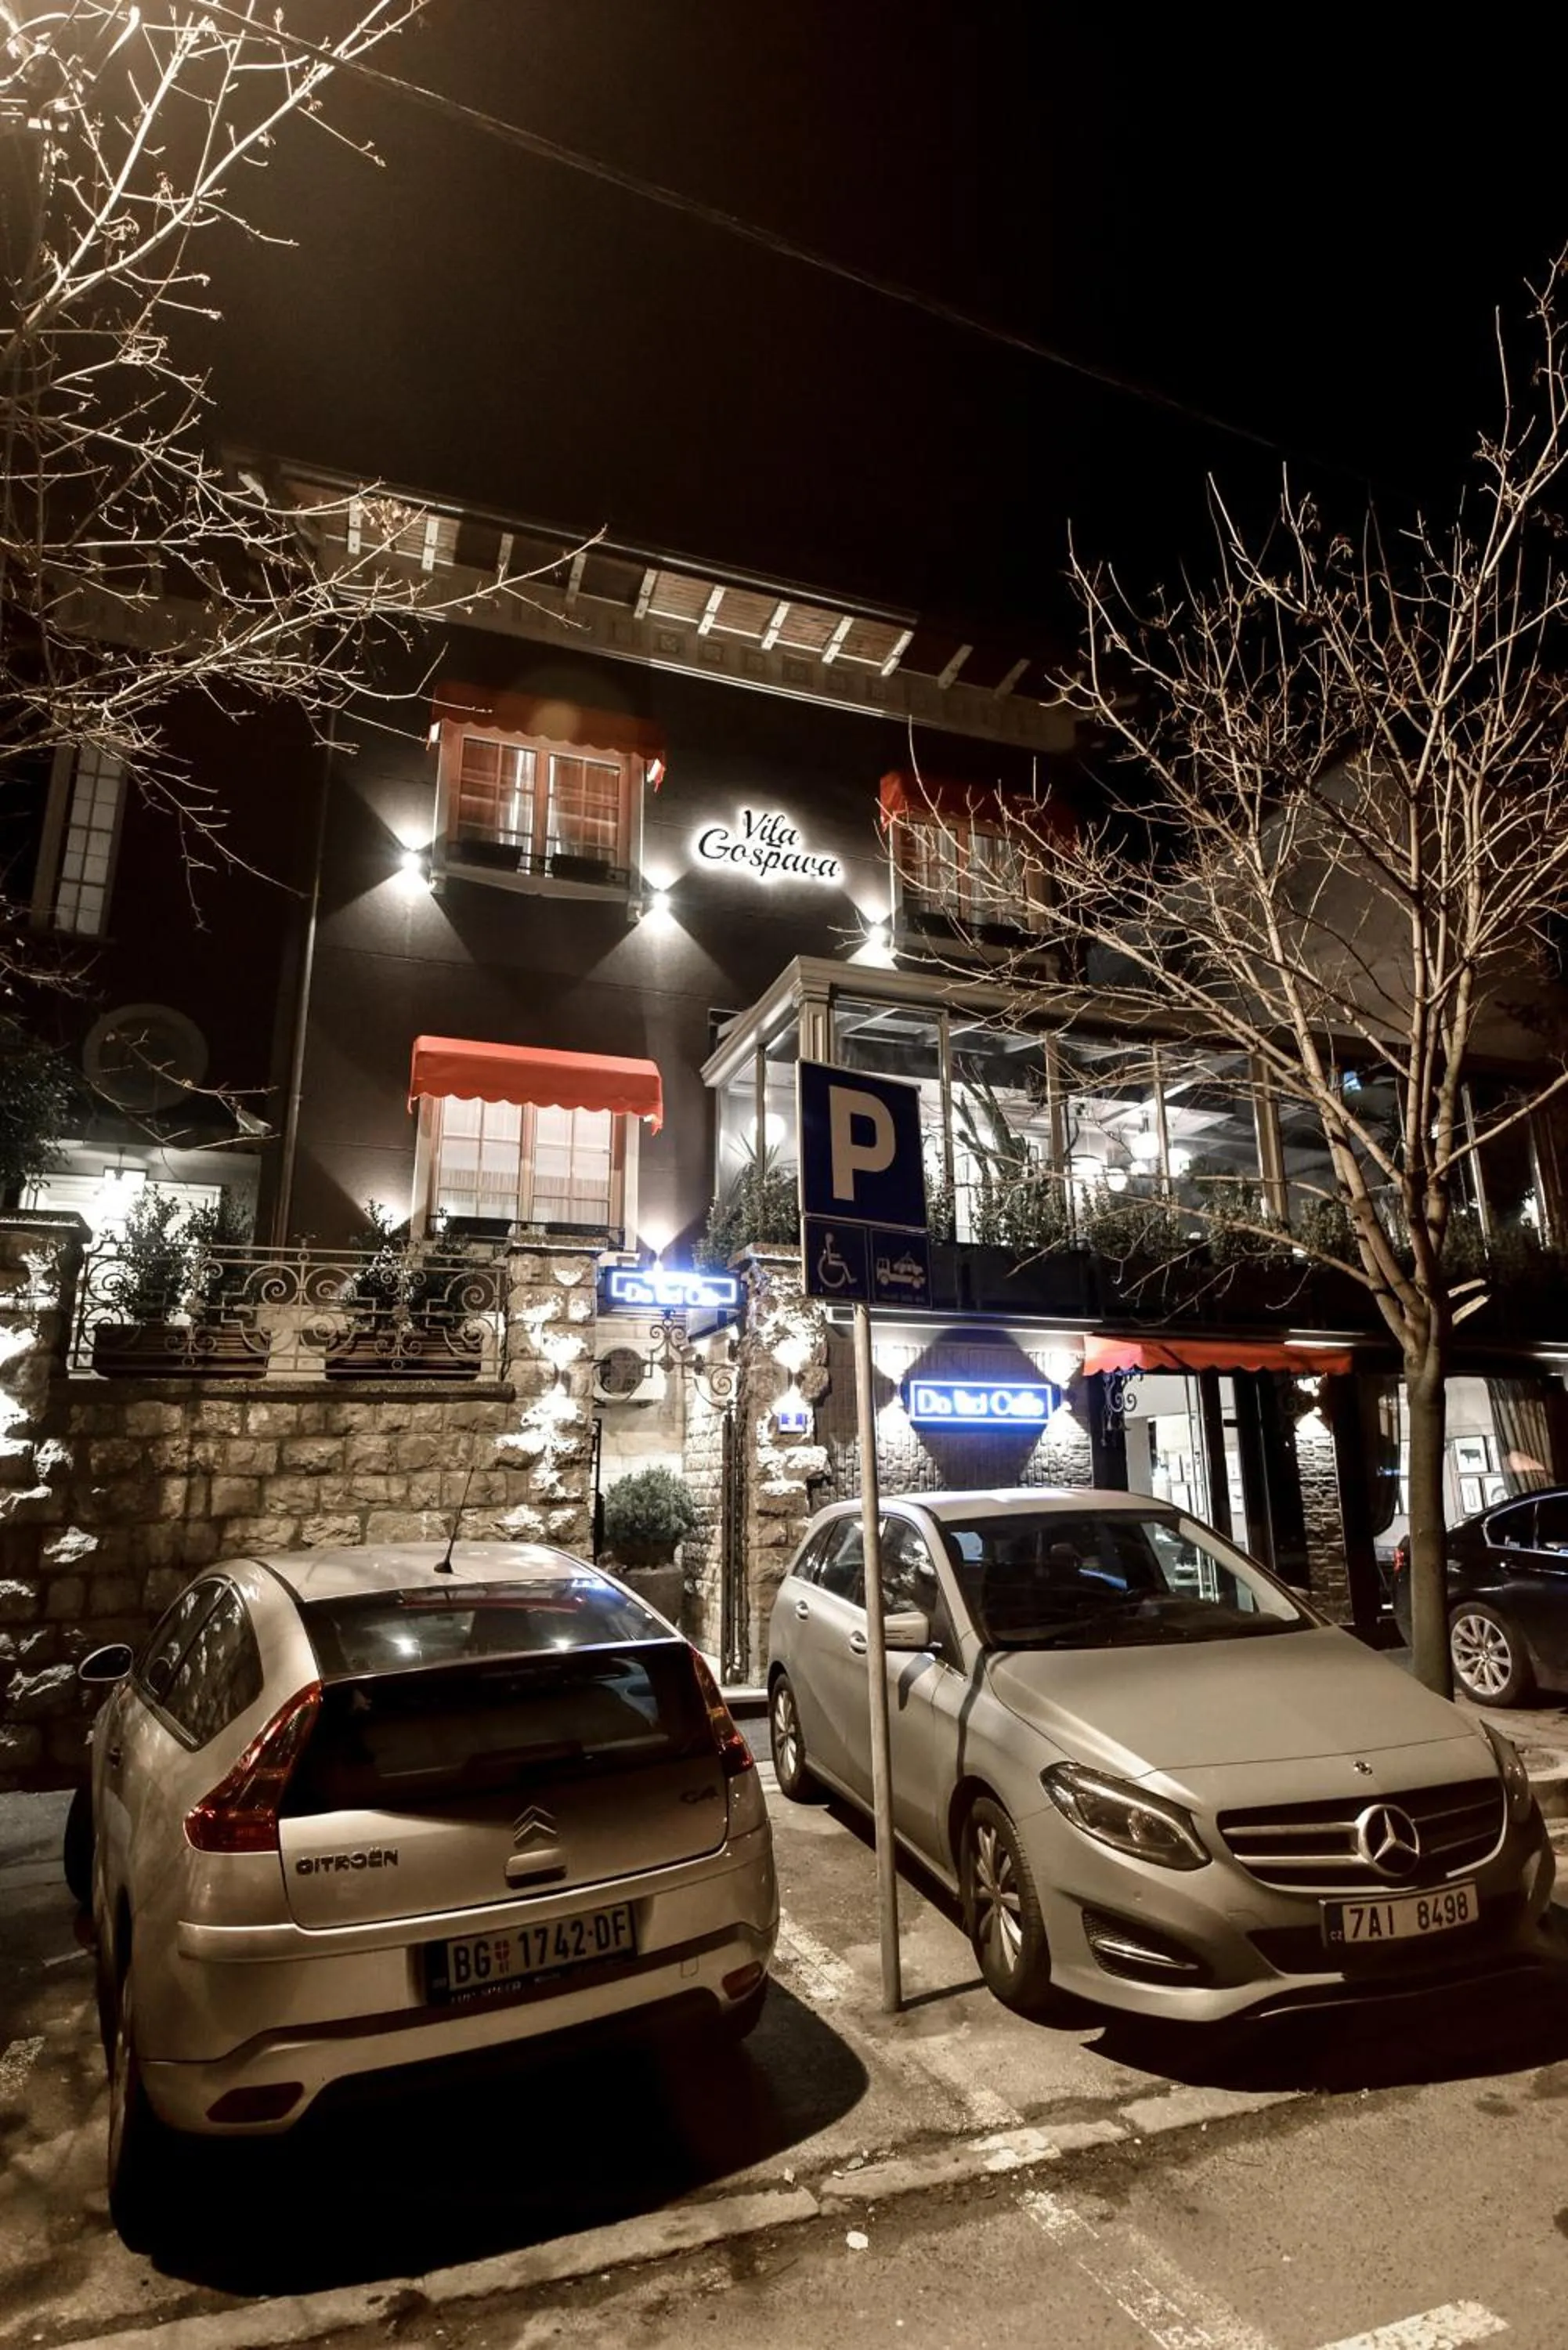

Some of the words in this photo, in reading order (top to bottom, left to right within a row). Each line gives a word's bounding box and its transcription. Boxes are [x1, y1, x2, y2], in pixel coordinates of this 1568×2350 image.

[744, 809, 799, 845] Vila
[698, 828, 840, 876] Gospava
[829, 1085, 897, 1202] P
[295, 1847, 399, 1875] CITROËN
[1349, 1904, 1395, 1939] 7AI
[1417, 1891, 1469, 1930] 8498
[453, 1938, 491, 1983] BG
